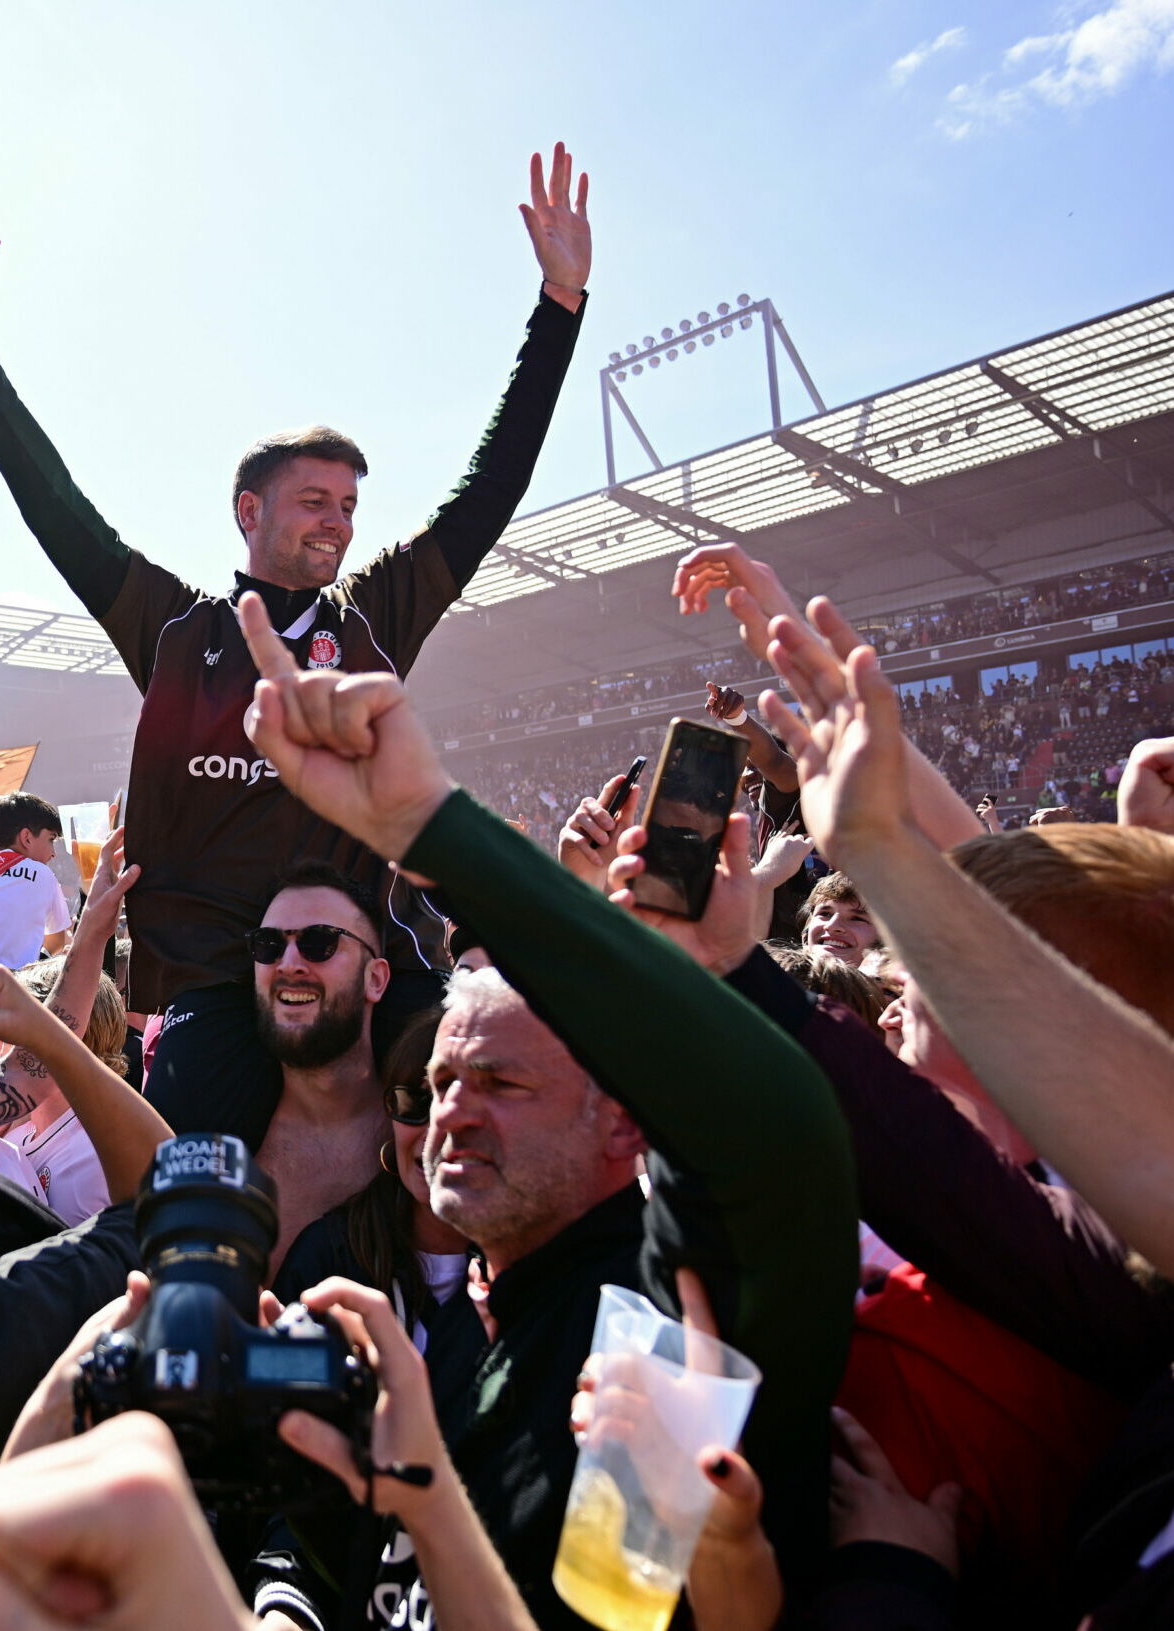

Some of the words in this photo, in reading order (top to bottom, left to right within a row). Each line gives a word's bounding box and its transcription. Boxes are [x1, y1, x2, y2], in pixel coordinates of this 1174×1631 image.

[316, 661, 334, 669] 1910
[169, 1140, 226, 1159] NOAH
[165, 1155, 230, 1176] WEDEL
